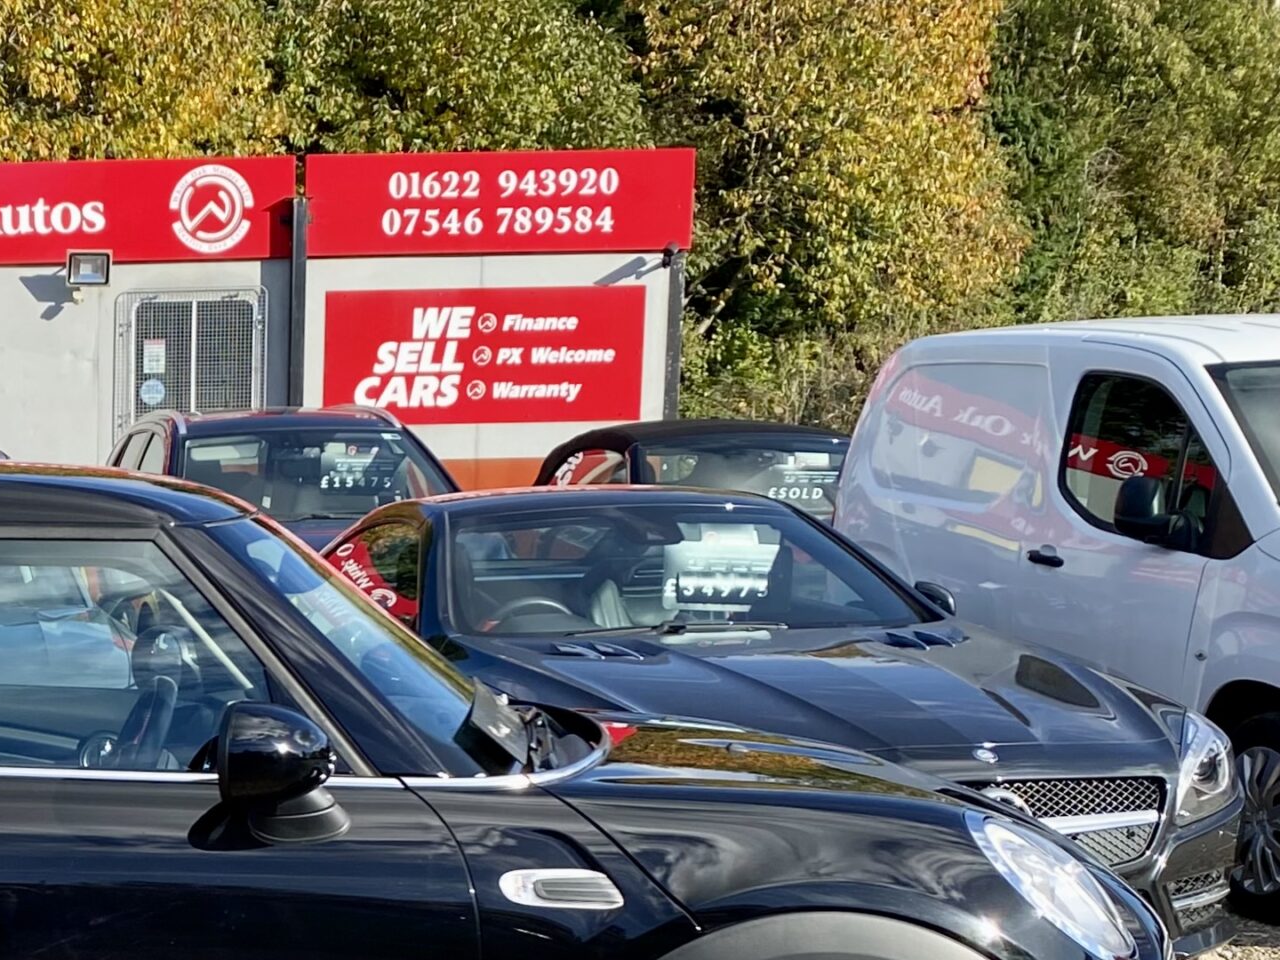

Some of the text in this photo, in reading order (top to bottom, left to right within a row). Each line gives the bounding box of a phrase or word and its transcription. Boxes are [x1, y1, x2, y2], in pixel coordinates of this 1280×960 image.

[388, 168, 619, 199] 01622 943920
[382, 206, 615, 236] 07546 789584
[413, 306, 476, 340] WE
[502, 313, 579, 332] Finance
[373, 341, 464, 375] SELL
[496, 346, 616, 365] PX Welcome
[353, 374, 461, 408] CARS
[492, 380, 583, 403] Warranty
